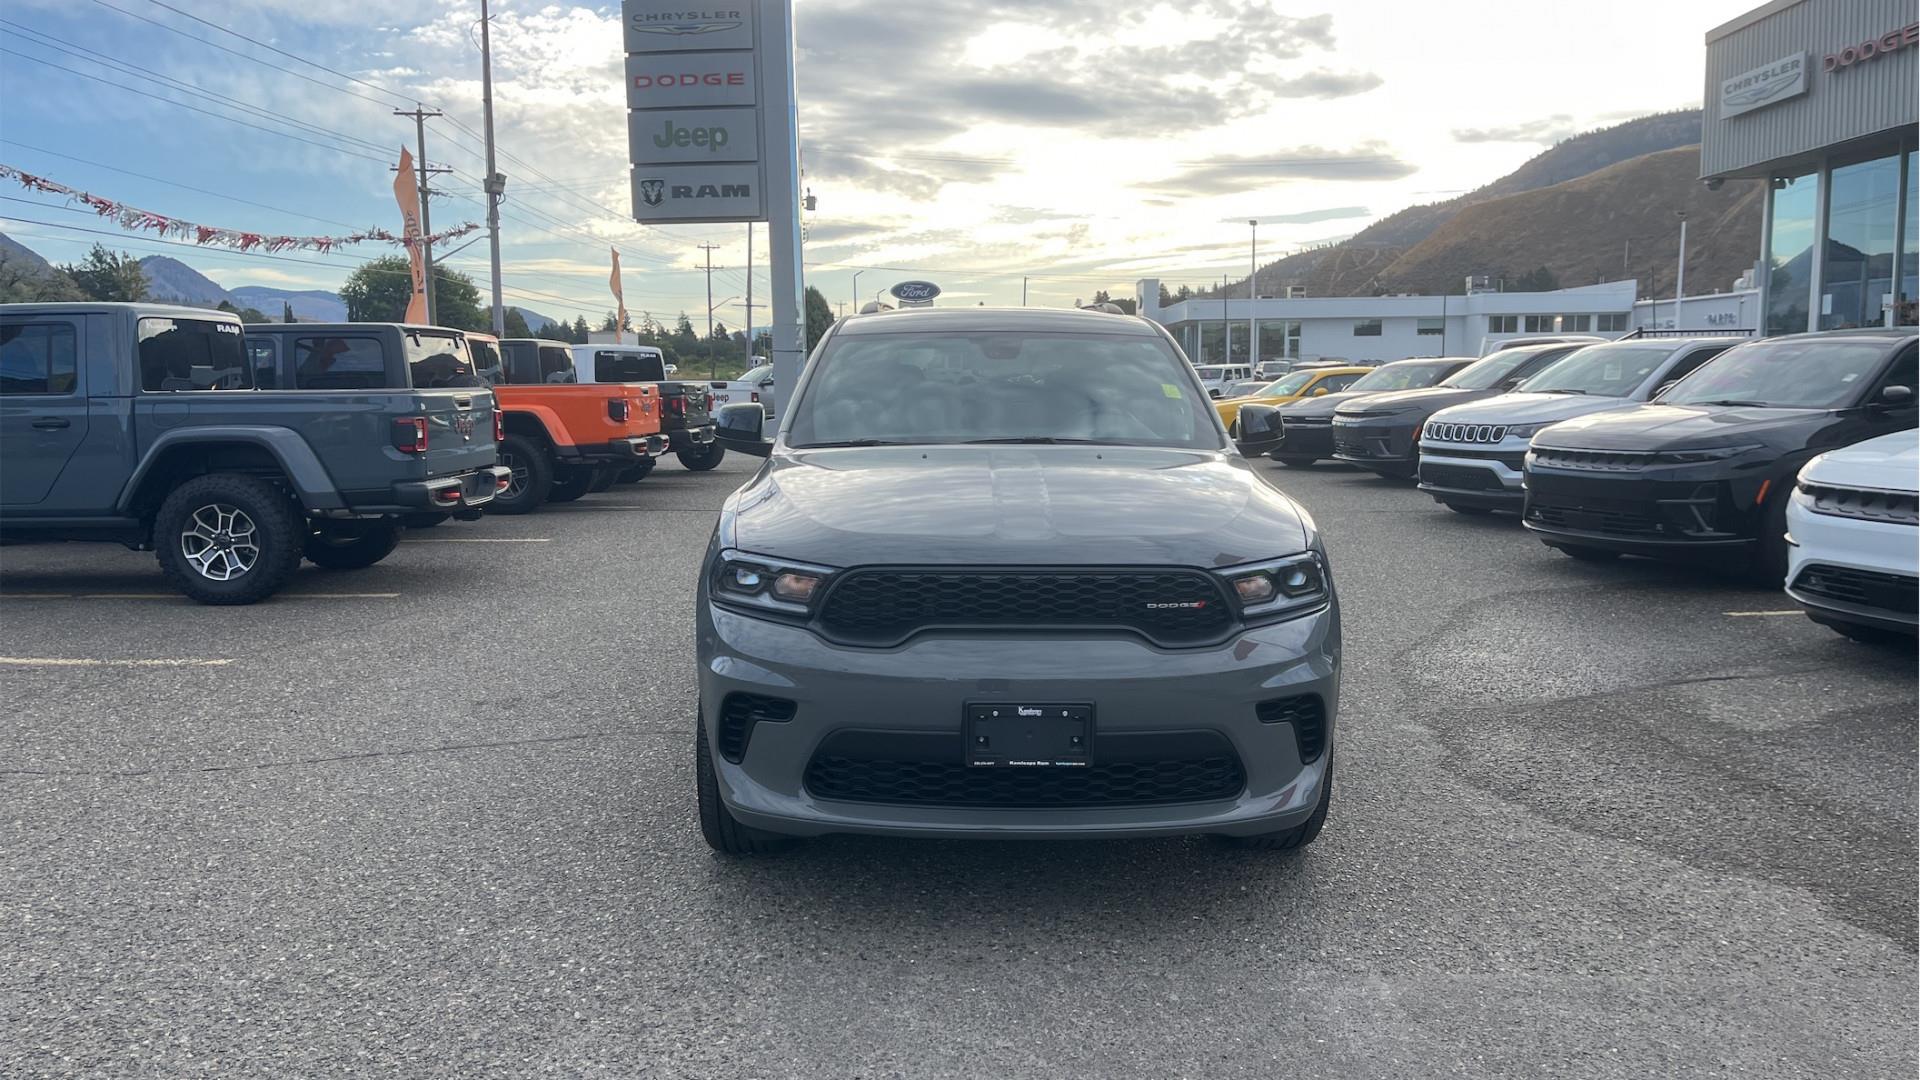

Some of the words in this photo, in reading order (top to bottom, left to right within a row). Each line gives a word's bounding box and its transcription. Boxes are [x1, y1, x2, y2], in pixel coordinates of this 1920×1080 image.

[632, 10, 741, 23] CHRYSLER
[1823, 21, 1920, 73] DODGE
[634, 72, 745, 89] DODGE
[1724, 59, 1800, 95] CHRYSLER
[653, 120, 729, 151] Jeep
[671, 184, 750, 199] RAM
[900, 284, 931, 297] Ford
[216, 324, 240, 335] RAM
[710, 391, 730, 403] Jeep
